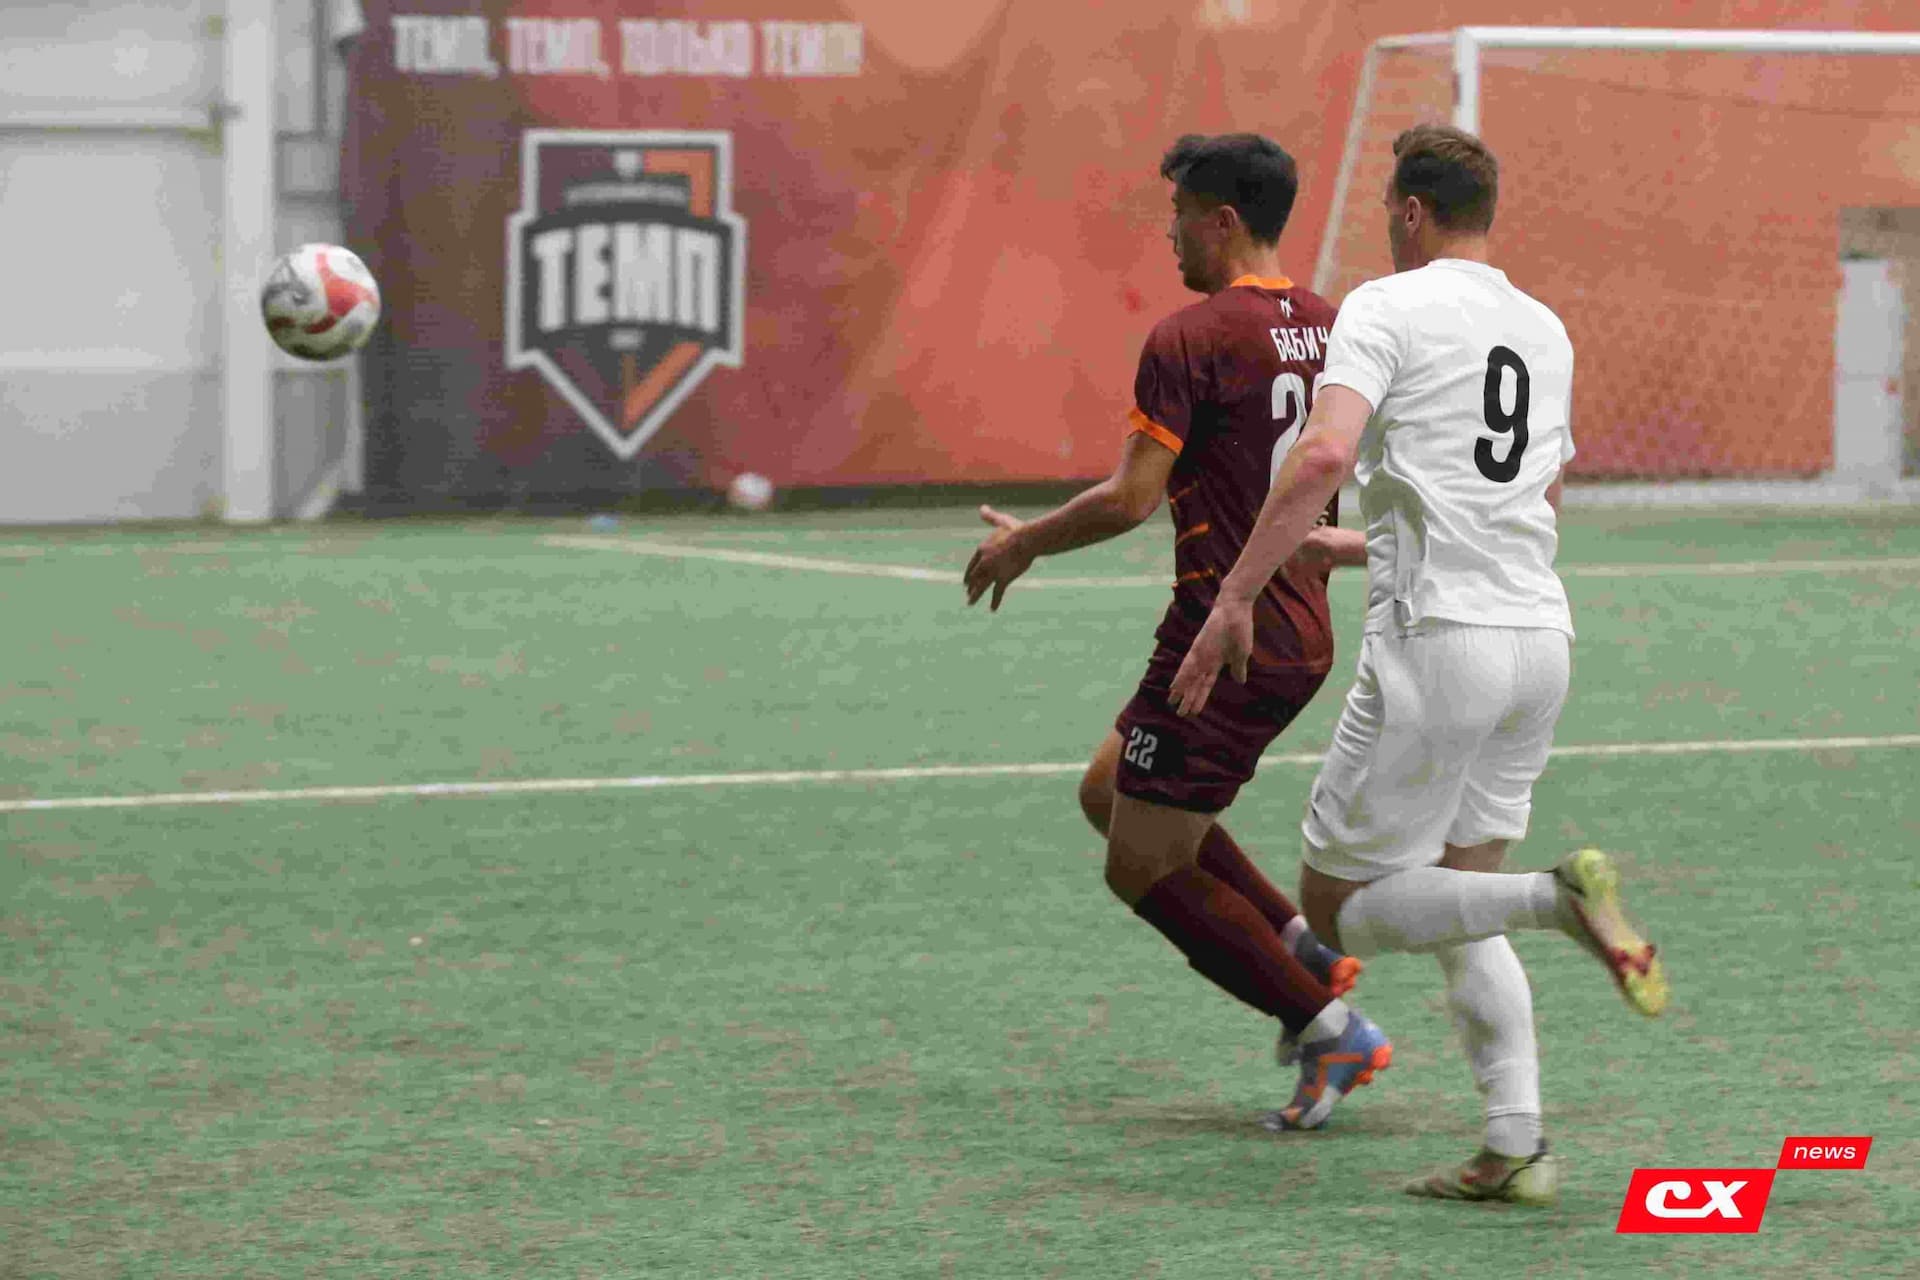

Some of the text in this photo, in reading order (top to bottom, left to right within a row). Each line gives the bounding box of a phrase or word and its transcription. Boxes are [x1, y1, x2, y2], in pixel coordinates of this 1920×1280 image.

[530, 221, 722, 334] ТЕМП
[1269, 372, 1325, 492] 2
[1474, 345, 1530, 483] 9
[1125, 726, 1158, 770] 22
